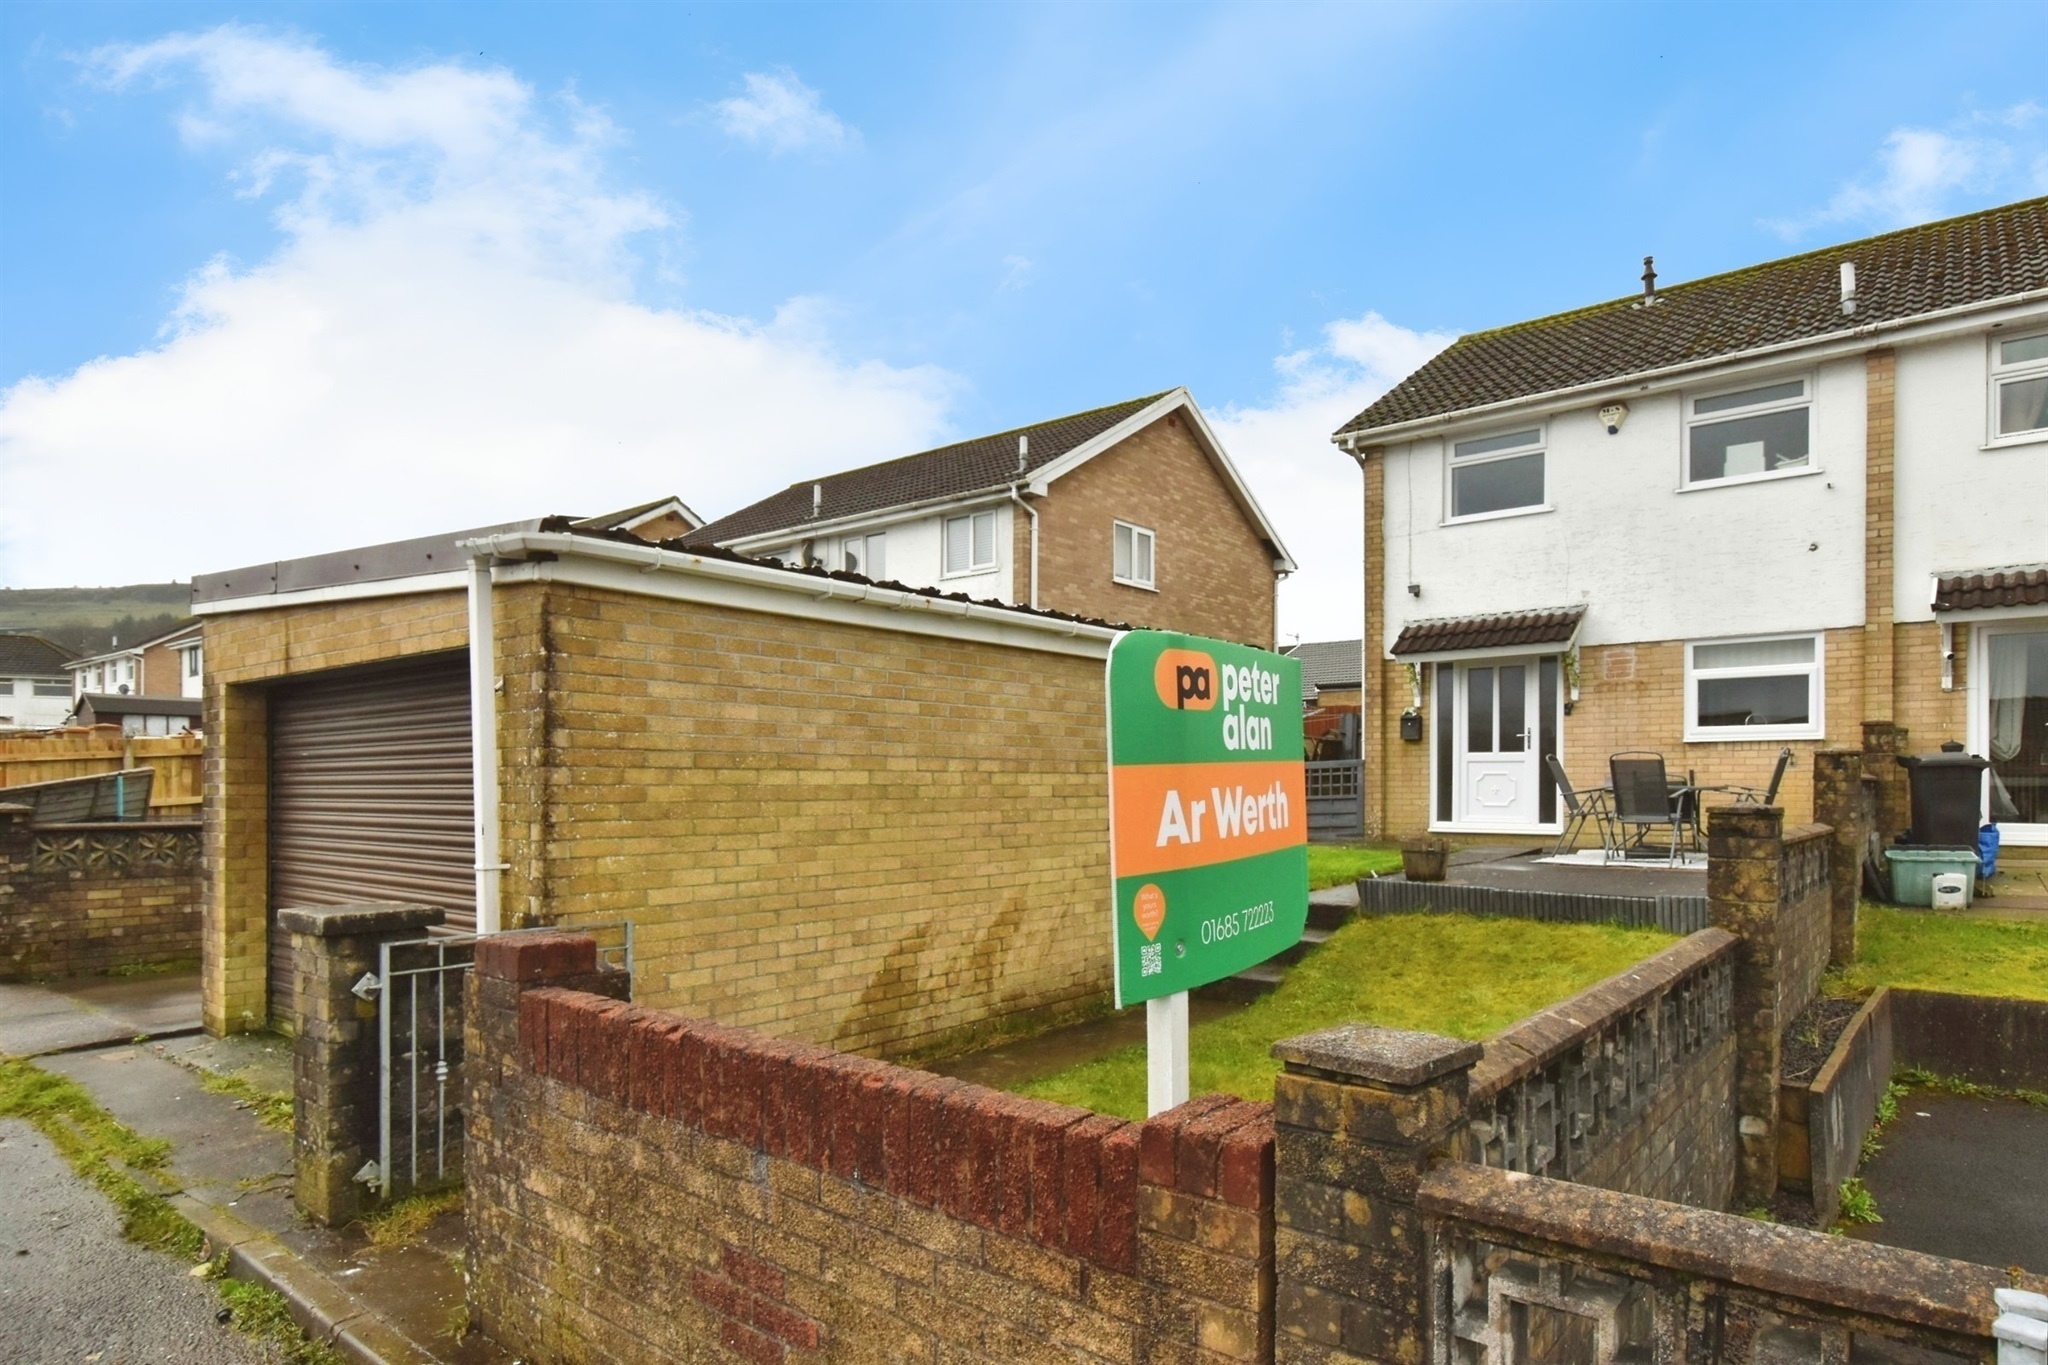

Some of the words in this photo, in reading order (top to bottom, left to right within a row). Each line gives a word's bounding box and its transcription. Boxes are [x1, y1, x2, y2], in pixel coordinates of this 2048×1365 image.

[1176, 665, 1210, 710] pa
[1222, 661, 1279, 711] peter
[1223, 704, 1272, 750] alan
[1155, 790, 1206, 847] Ar
[1211, 781, 1288, 839] Werth
[1201, 913, 1240, 944] 01685
[1241, 900, 1275, 932] 722223
